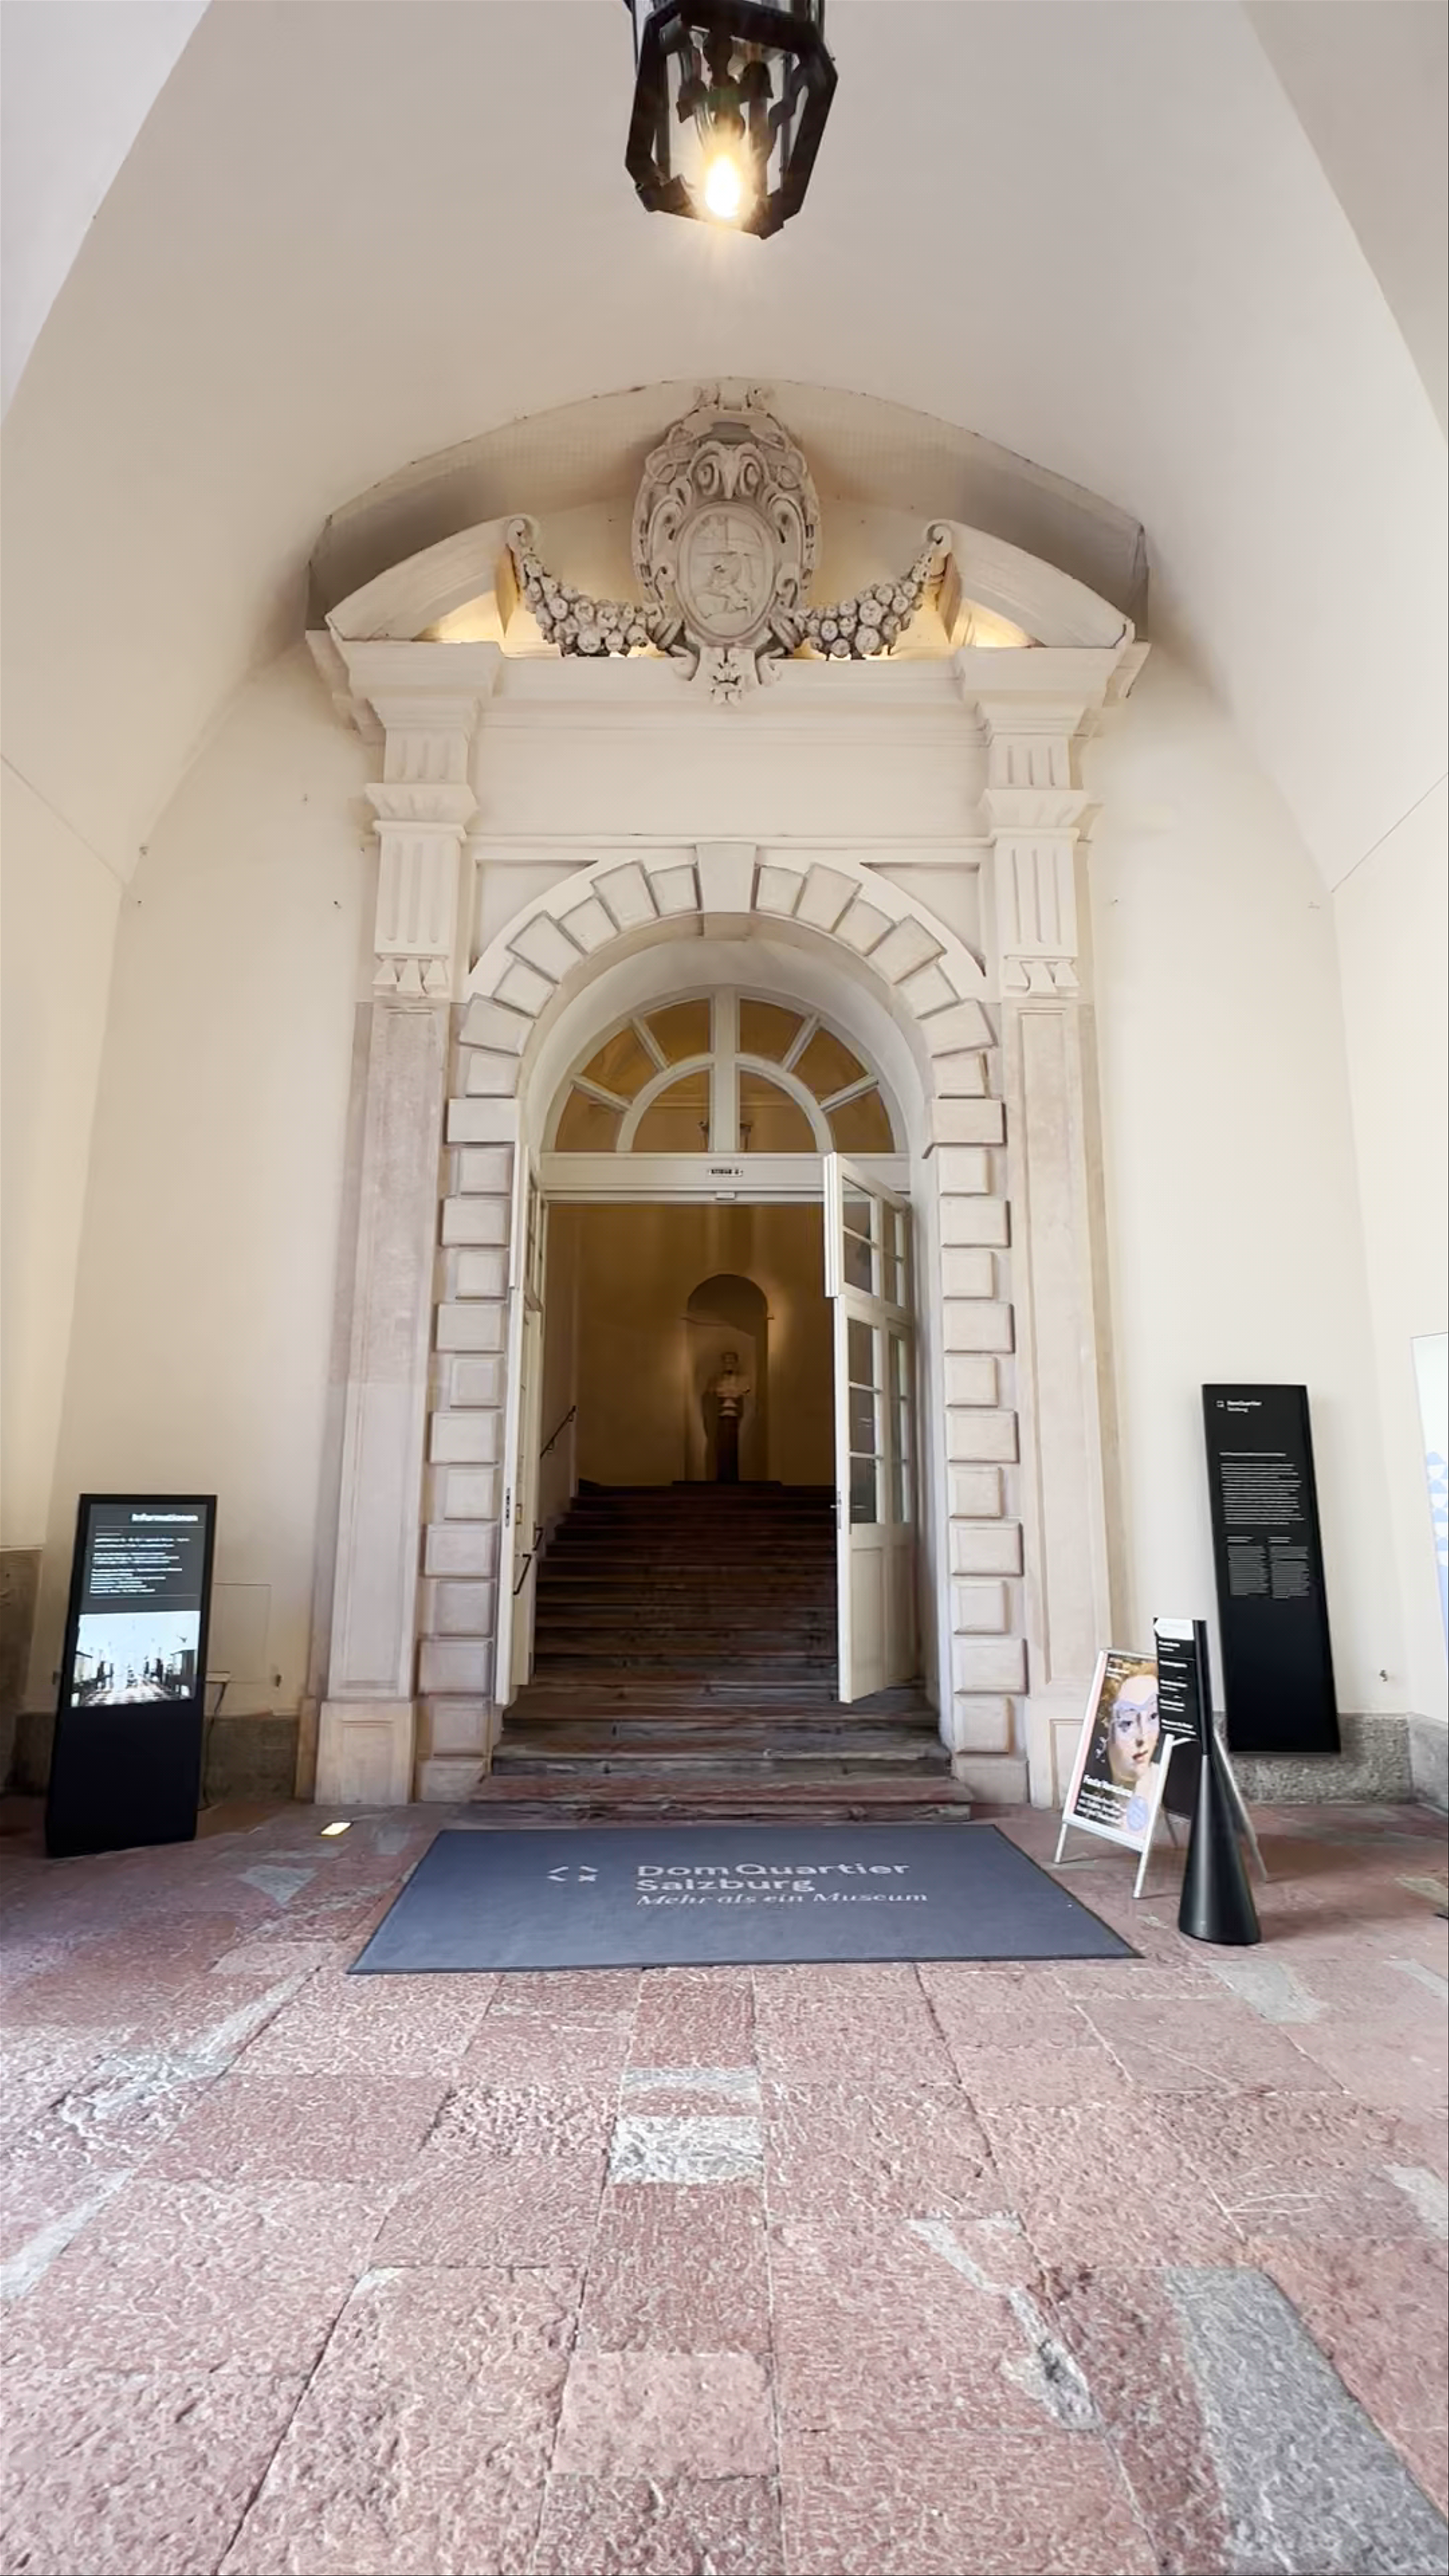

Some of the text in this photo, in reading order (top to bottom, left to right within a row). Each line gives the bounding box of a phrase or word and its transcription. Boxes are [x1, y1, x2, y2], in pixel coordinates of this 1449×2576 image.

[638, 1862, 910, 1877] DomQuartier
[636, 1878, 815, 1892] Salzburg
[636, 1892, 928, 1905] Mehr als ein Museum
